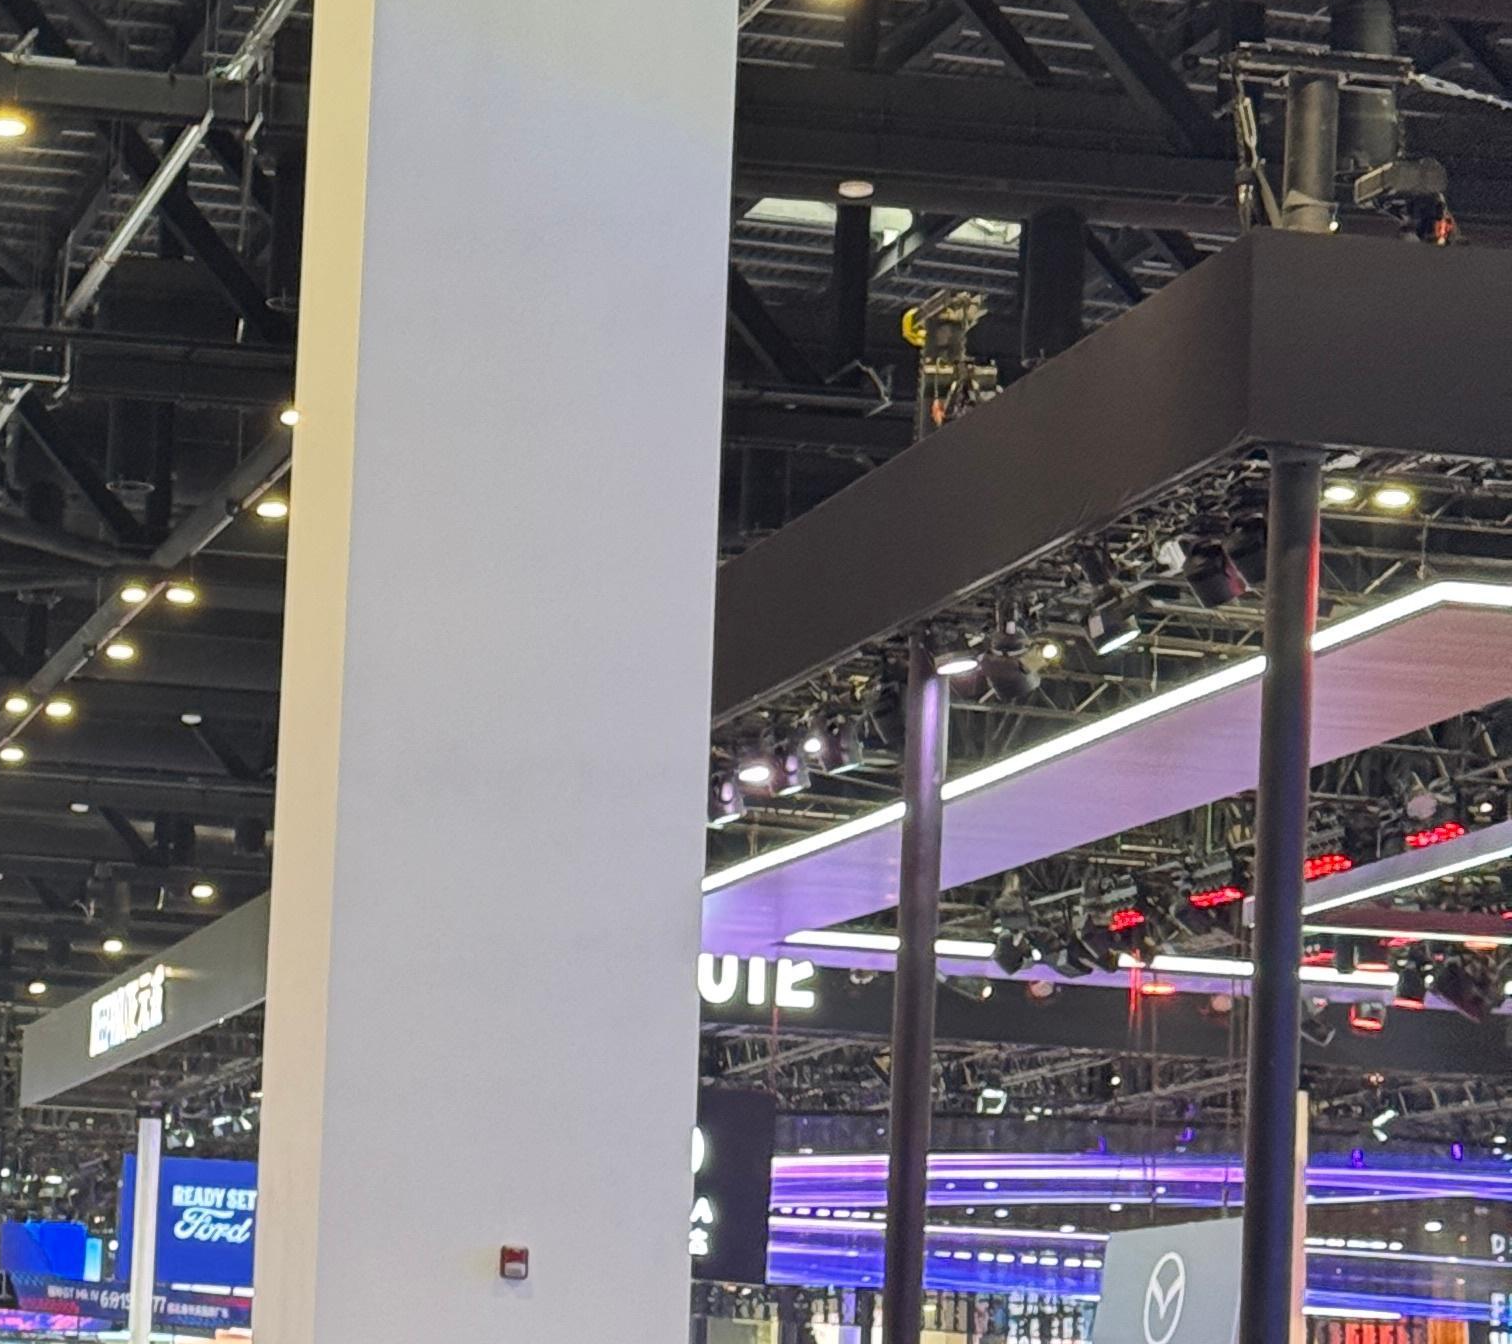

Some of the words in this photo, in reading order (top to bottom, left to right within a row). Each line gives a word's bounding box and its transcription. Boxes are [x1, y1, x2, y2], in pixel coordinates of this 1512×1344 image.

[172, 1185, 226, 1208] READY
[226, 1187, 258, 1211] SET
[174, 1207, 253, 1244] Ford
